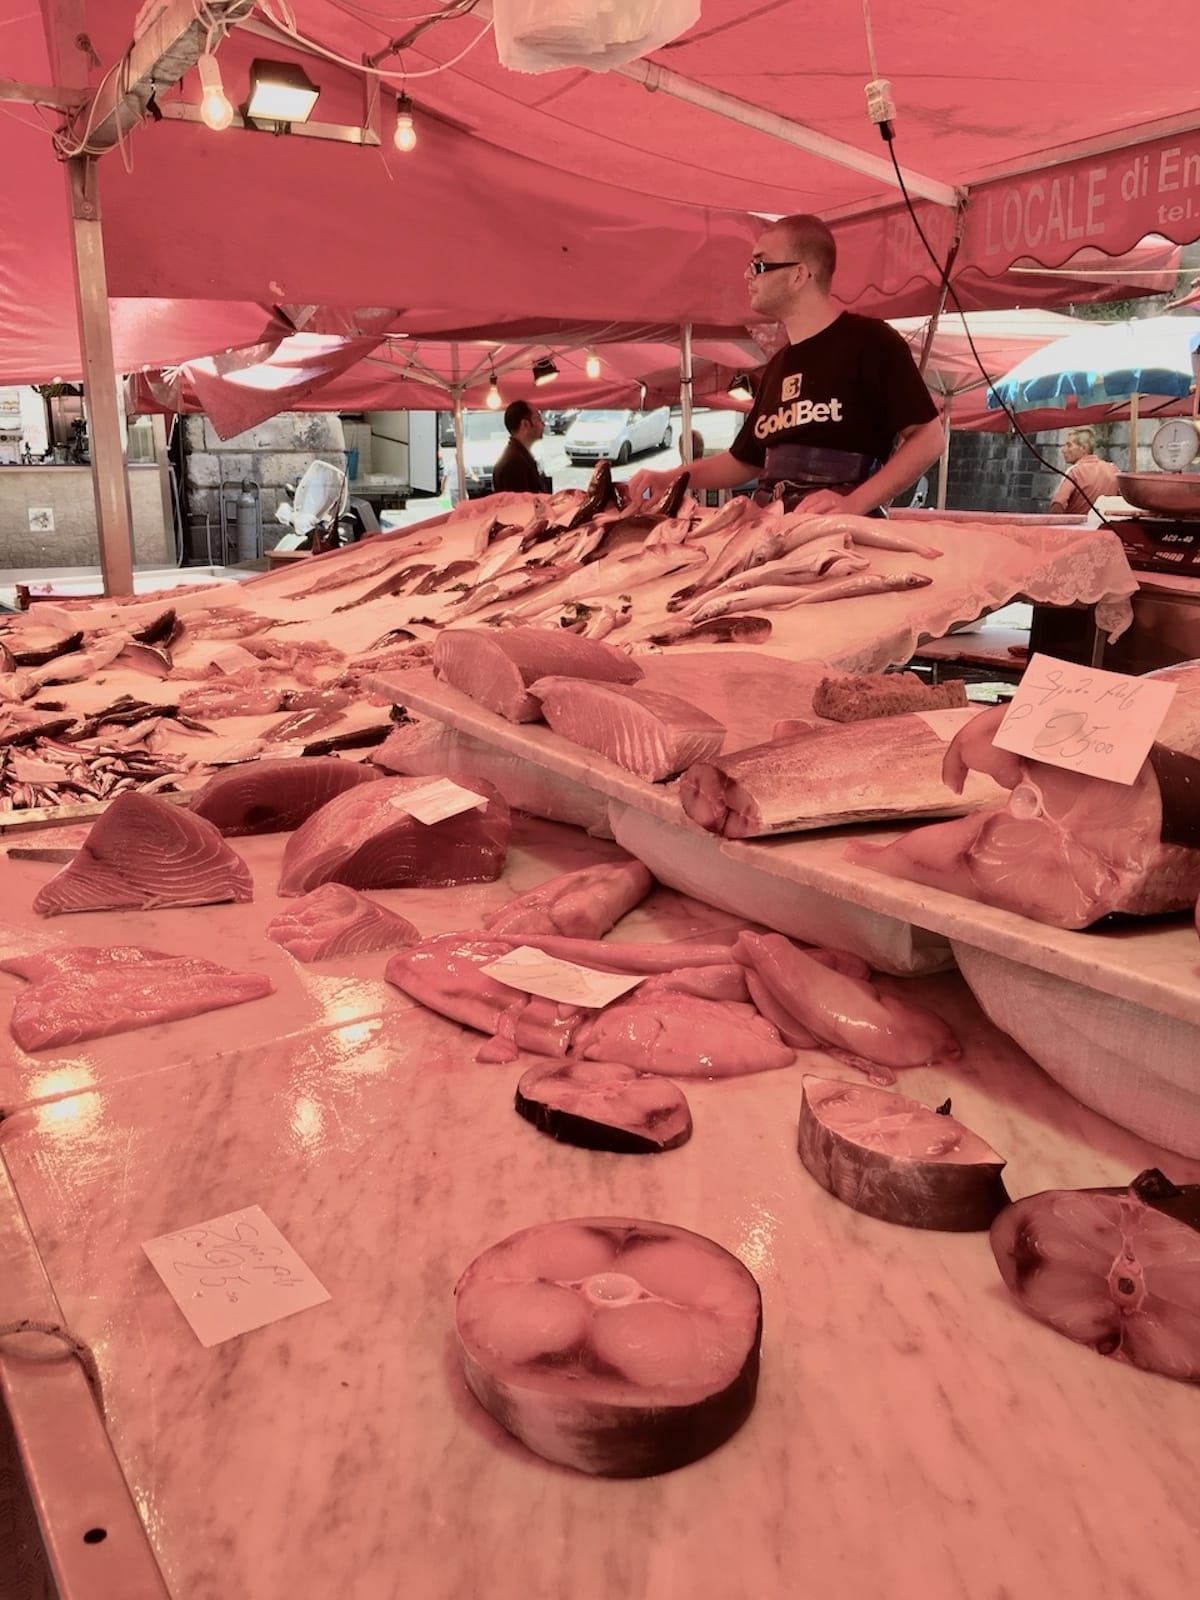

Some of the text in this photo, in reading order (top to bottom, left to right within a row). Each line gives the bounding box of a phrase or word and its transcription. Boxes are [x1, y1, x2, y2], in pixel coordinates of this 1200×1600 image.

[984, 168, 1107, 256] LOCALE
[1121, 154, 1149, 201] di
[1157, 198, 1199, 225] tel.
[754, 398, 843, 439] GoldBet
